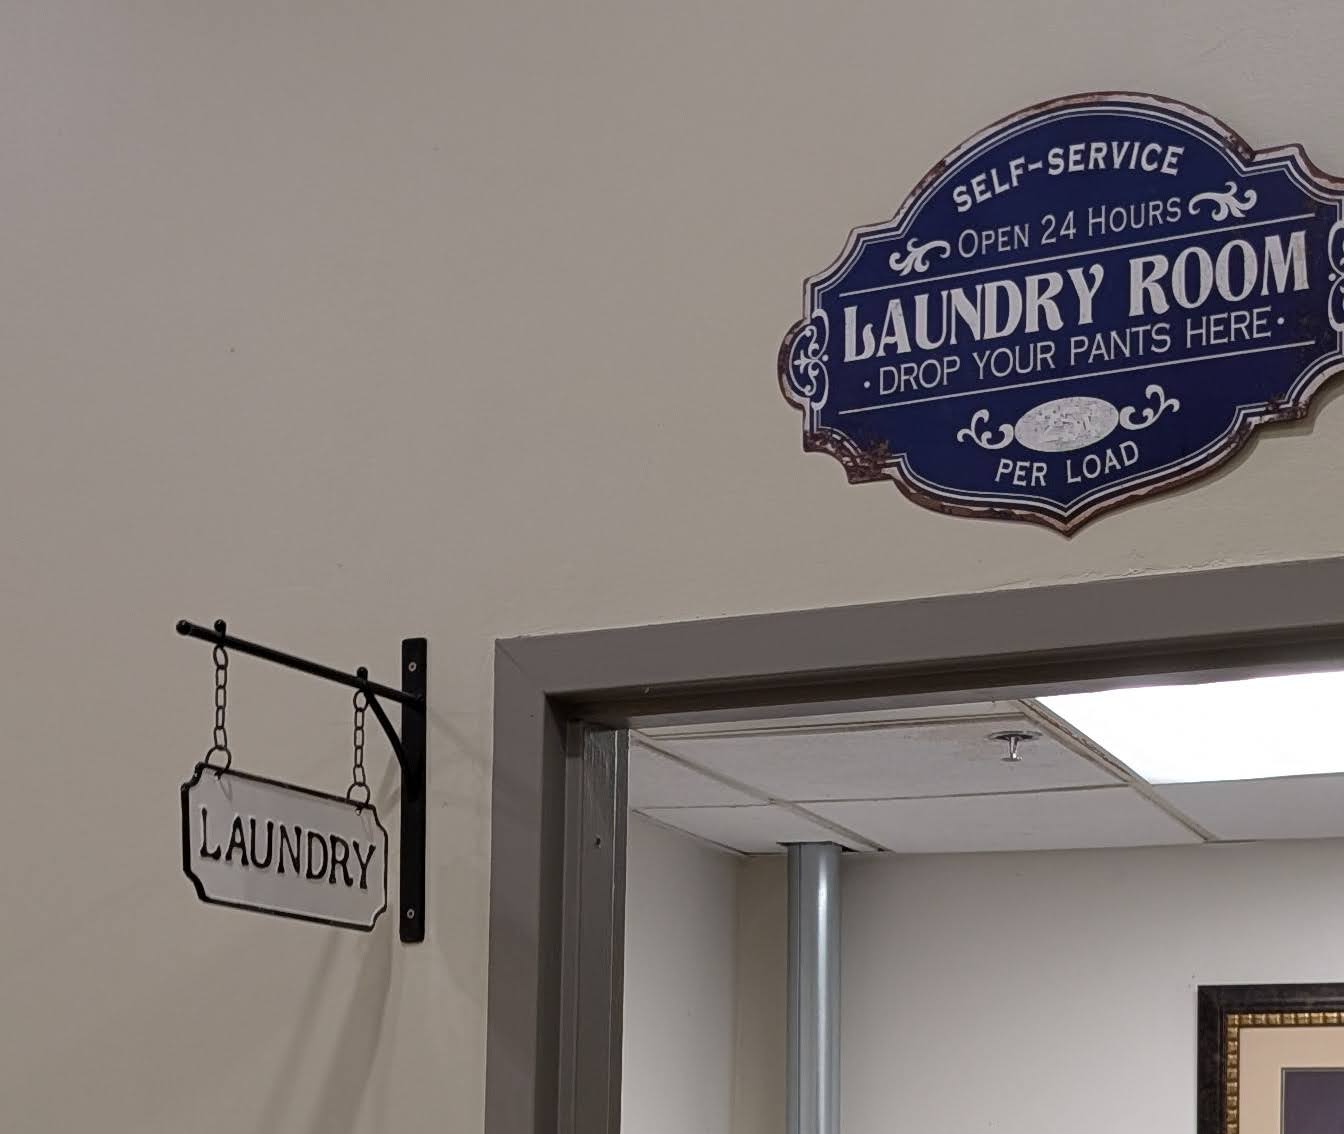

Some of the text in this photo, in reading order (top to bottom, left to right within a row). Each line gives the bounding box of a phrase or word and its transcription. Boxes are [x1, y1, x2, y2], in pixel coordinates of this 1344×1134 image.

[952, 141, 1185, 213] SELF-SERVICE
[1041, 210, 1077, 245] 24
[843, 230, 1310, 363] LAUNDRY ROOM
[879, 306, 1272, 395] DROP YOUR PANTS HERE
[995, 440, 1139, 487] PER LOAD
[199, 807, 376, 890] LAUNDRY
